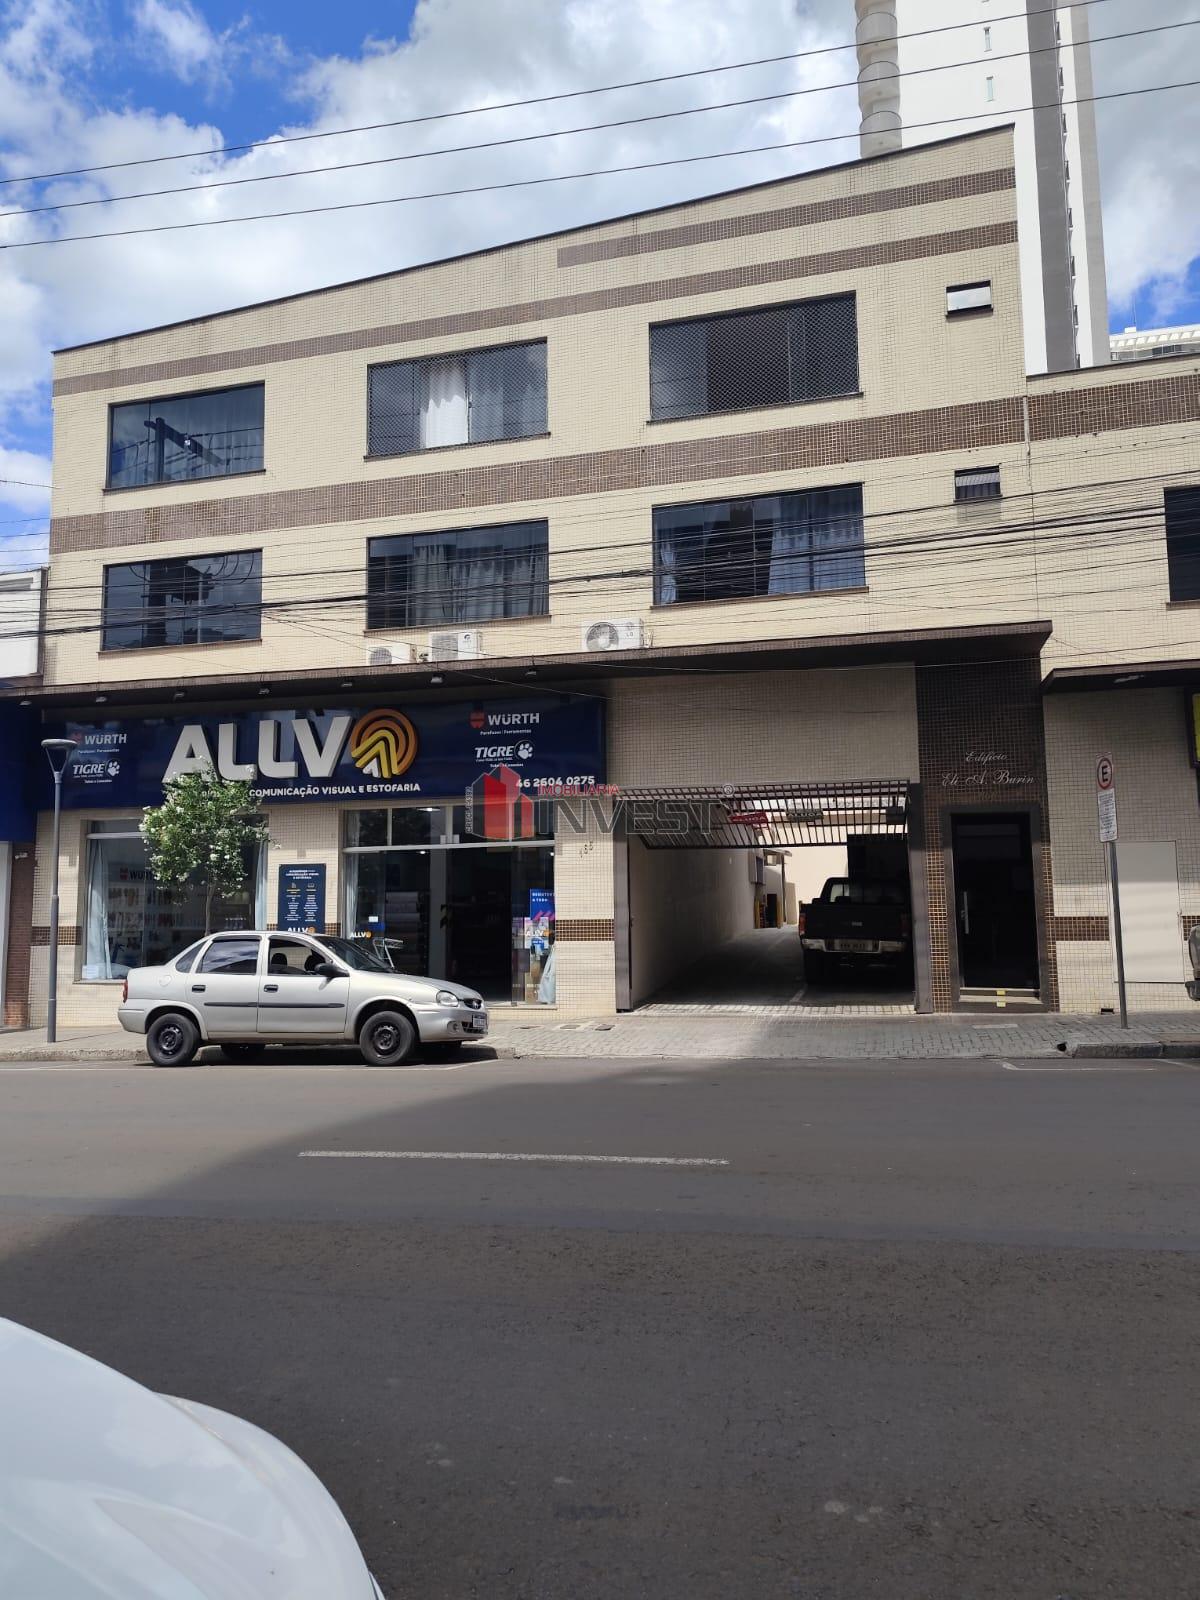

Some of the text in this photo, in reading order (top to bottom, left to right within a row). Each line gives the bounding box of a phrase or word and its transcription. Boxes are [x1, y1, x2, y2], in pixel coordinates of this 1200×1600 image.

[488, 712, 540, 726] WÜRTH
[84, 733, 127, 745] WÜRTH
[474, 745, 515, 759] TIGRE
[73, 763, 105, 775] TIGRE
[1101, 765, 1109, 783] E
[566, 775, 595, 787] 0275
[993, 769, 1035, 785] Burin
[249, 783, 421, 798] COMUNICAÇÃO VISUAL E ESTOFARIA
